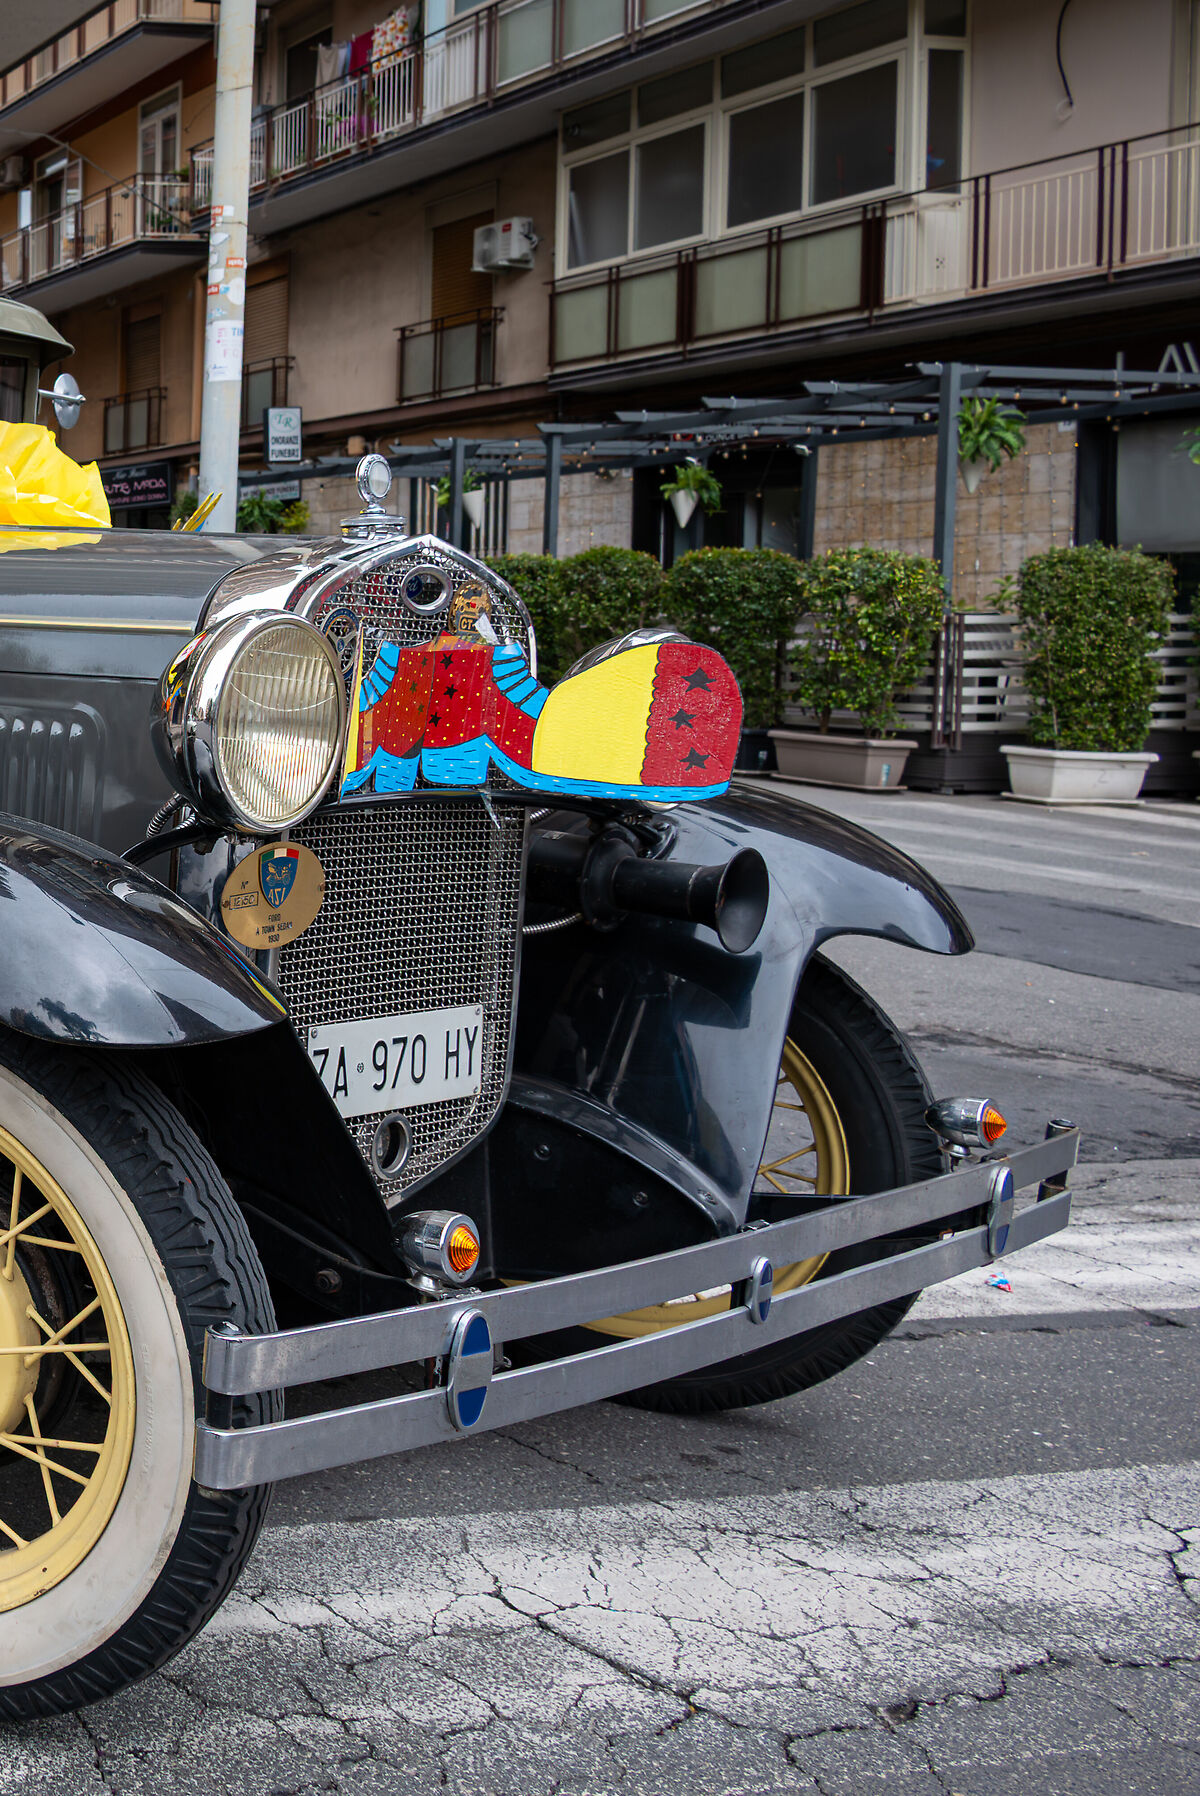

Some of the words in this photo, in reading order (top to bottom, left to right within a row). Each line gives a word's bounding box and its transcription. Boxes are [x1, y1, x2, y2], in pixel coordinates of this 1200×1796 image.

[271, 436, 299, 445] ONORANZE
[271, 449, 299, 458] FUNEBRI
[268, 887, 286, 906] ASI
[268, 914, 281, 922] FORD
[261, 925, 276, 935] TOWN
[277, 922, 293, 931] SEDAN
[372, 1034, 427, 1091] 970
[445, 1025, 478, 1080] HY
